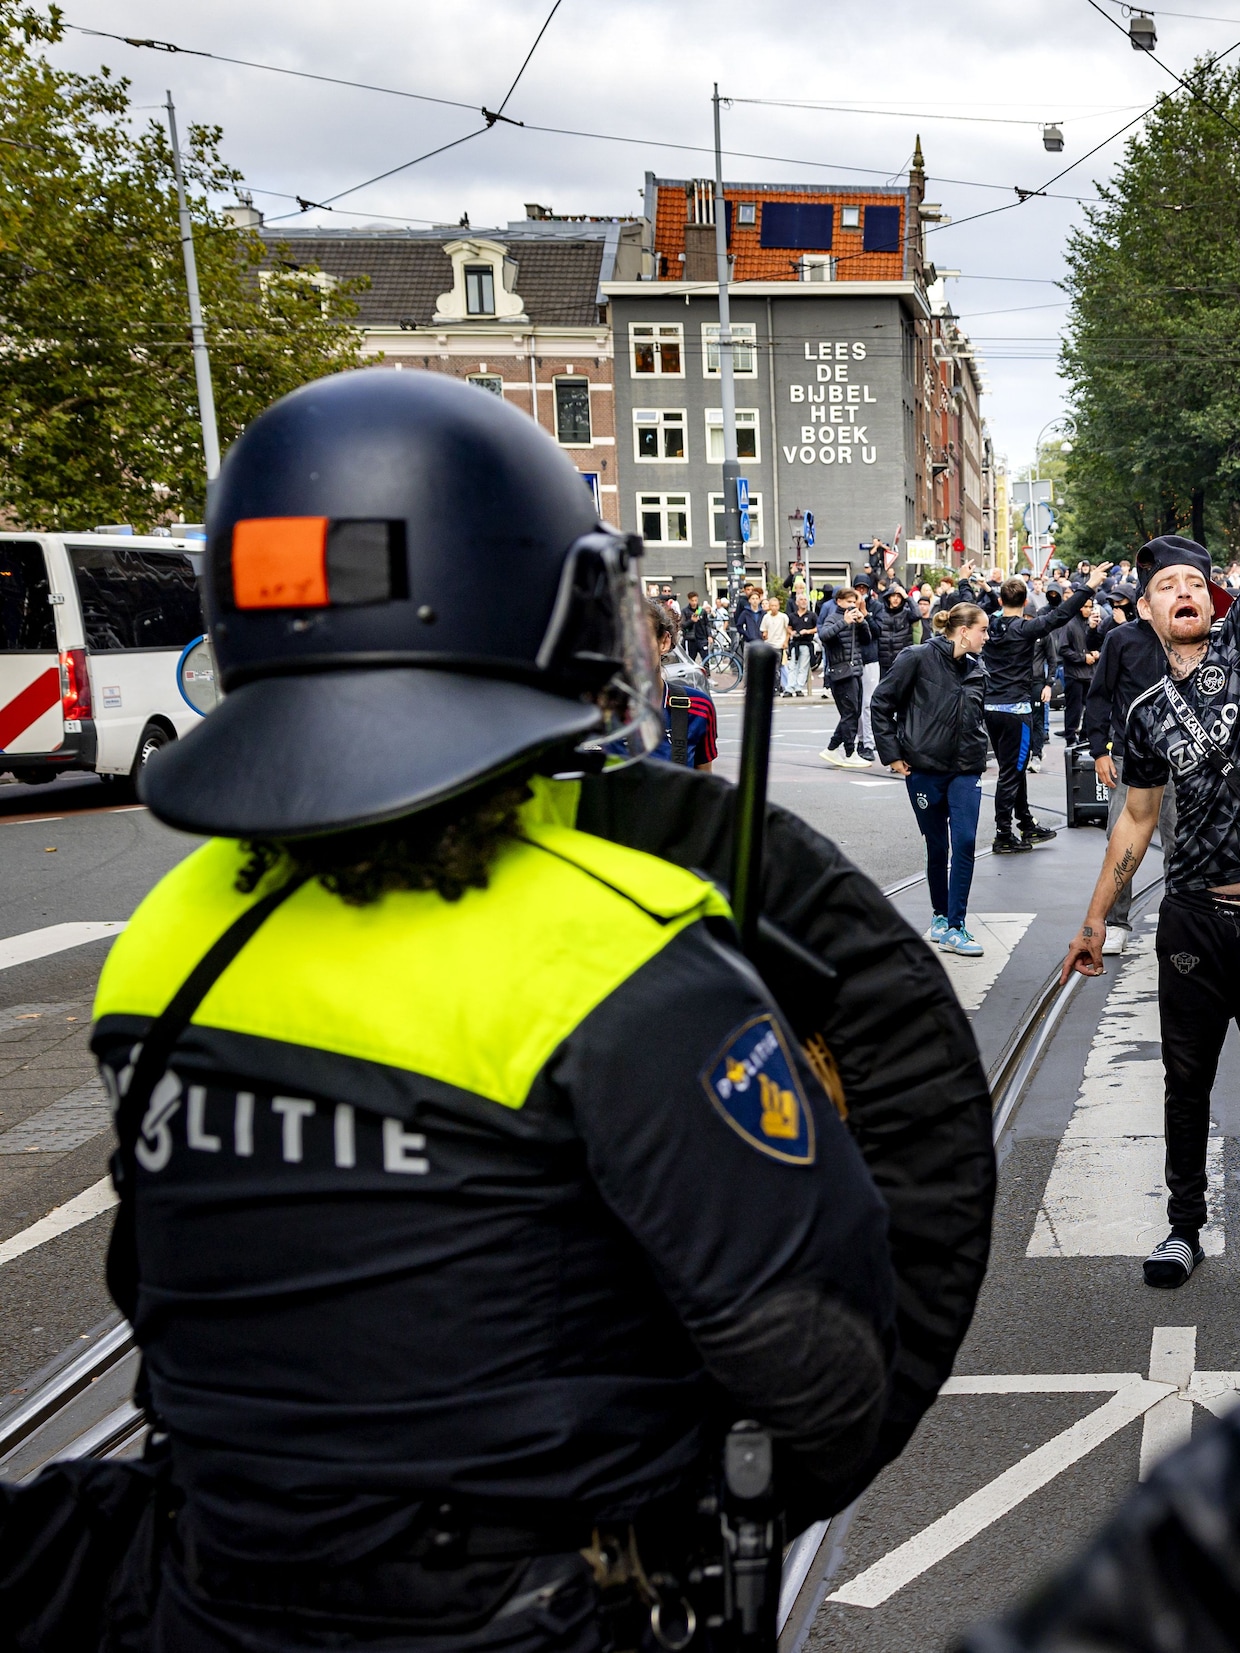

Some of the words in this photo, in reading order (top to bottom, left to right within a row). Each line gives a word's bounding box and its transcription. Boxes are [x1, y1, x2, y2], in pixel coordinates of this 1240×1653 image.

[804, 342, 867, 360] LEES
[816, 364, 849, 382] DE
[790, 385, 877, 403] BIJBEL
[811, 405, 859, 423] HET
[801, 426, 869, 444] BOEK
[782, 446, 852, 464] VOOR
[861, 446, 877, 464] U
